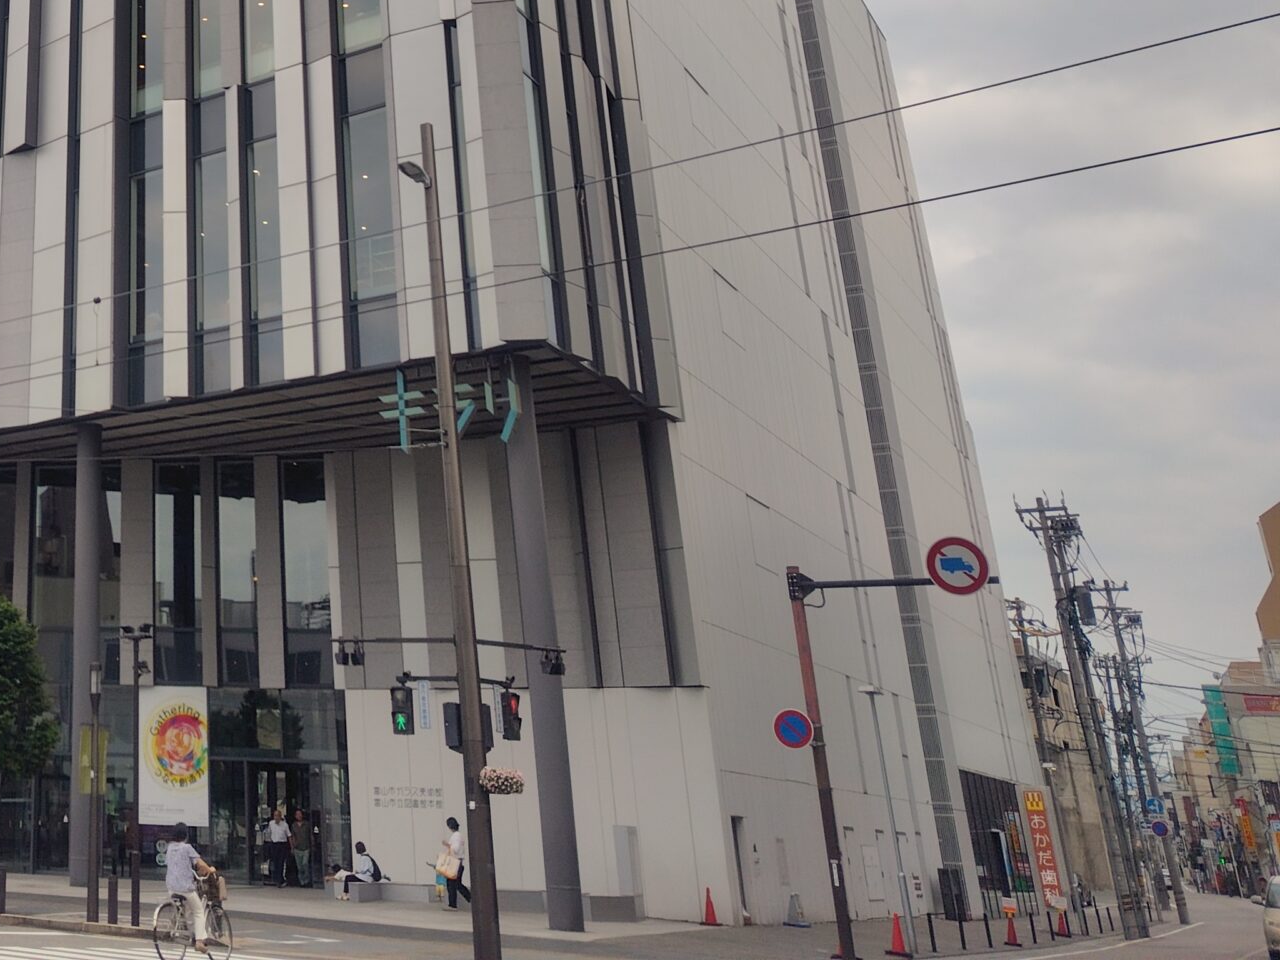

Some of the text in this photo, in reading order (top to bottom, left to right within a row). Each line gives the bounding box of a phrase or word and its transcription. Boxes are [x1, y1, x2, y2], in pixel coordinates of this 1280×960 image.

[149, 702, 201, 737] Gathering
[1030, 814, 1060, 904] おかだ歯科
